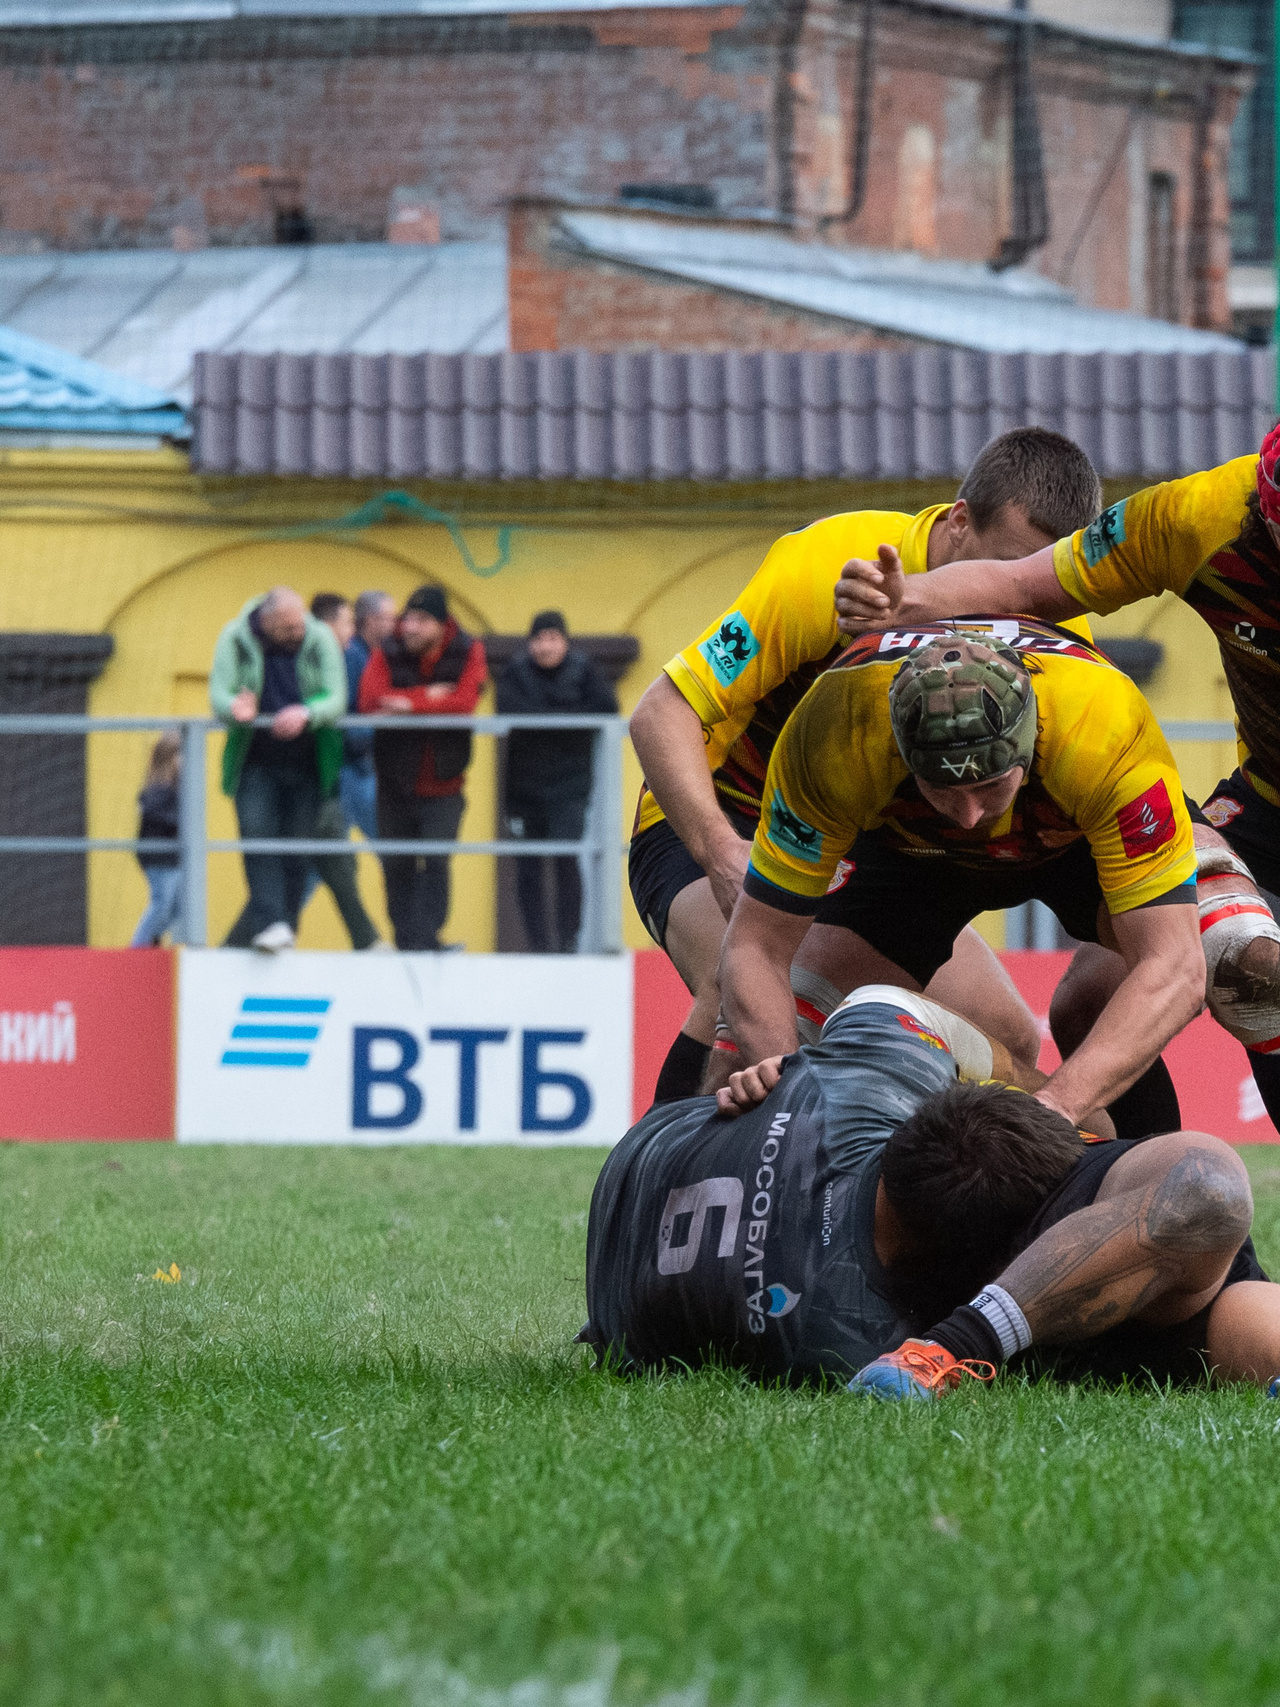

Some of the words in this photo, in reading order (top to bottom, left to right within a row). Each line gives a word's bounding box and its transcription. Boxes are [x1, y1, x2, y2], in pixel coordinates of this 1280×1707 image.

[351, 1026, 592, 1133] ВТБ
[657, 1176, 745, 1276] 6
[822, 1182, 834, 1246] centurion
